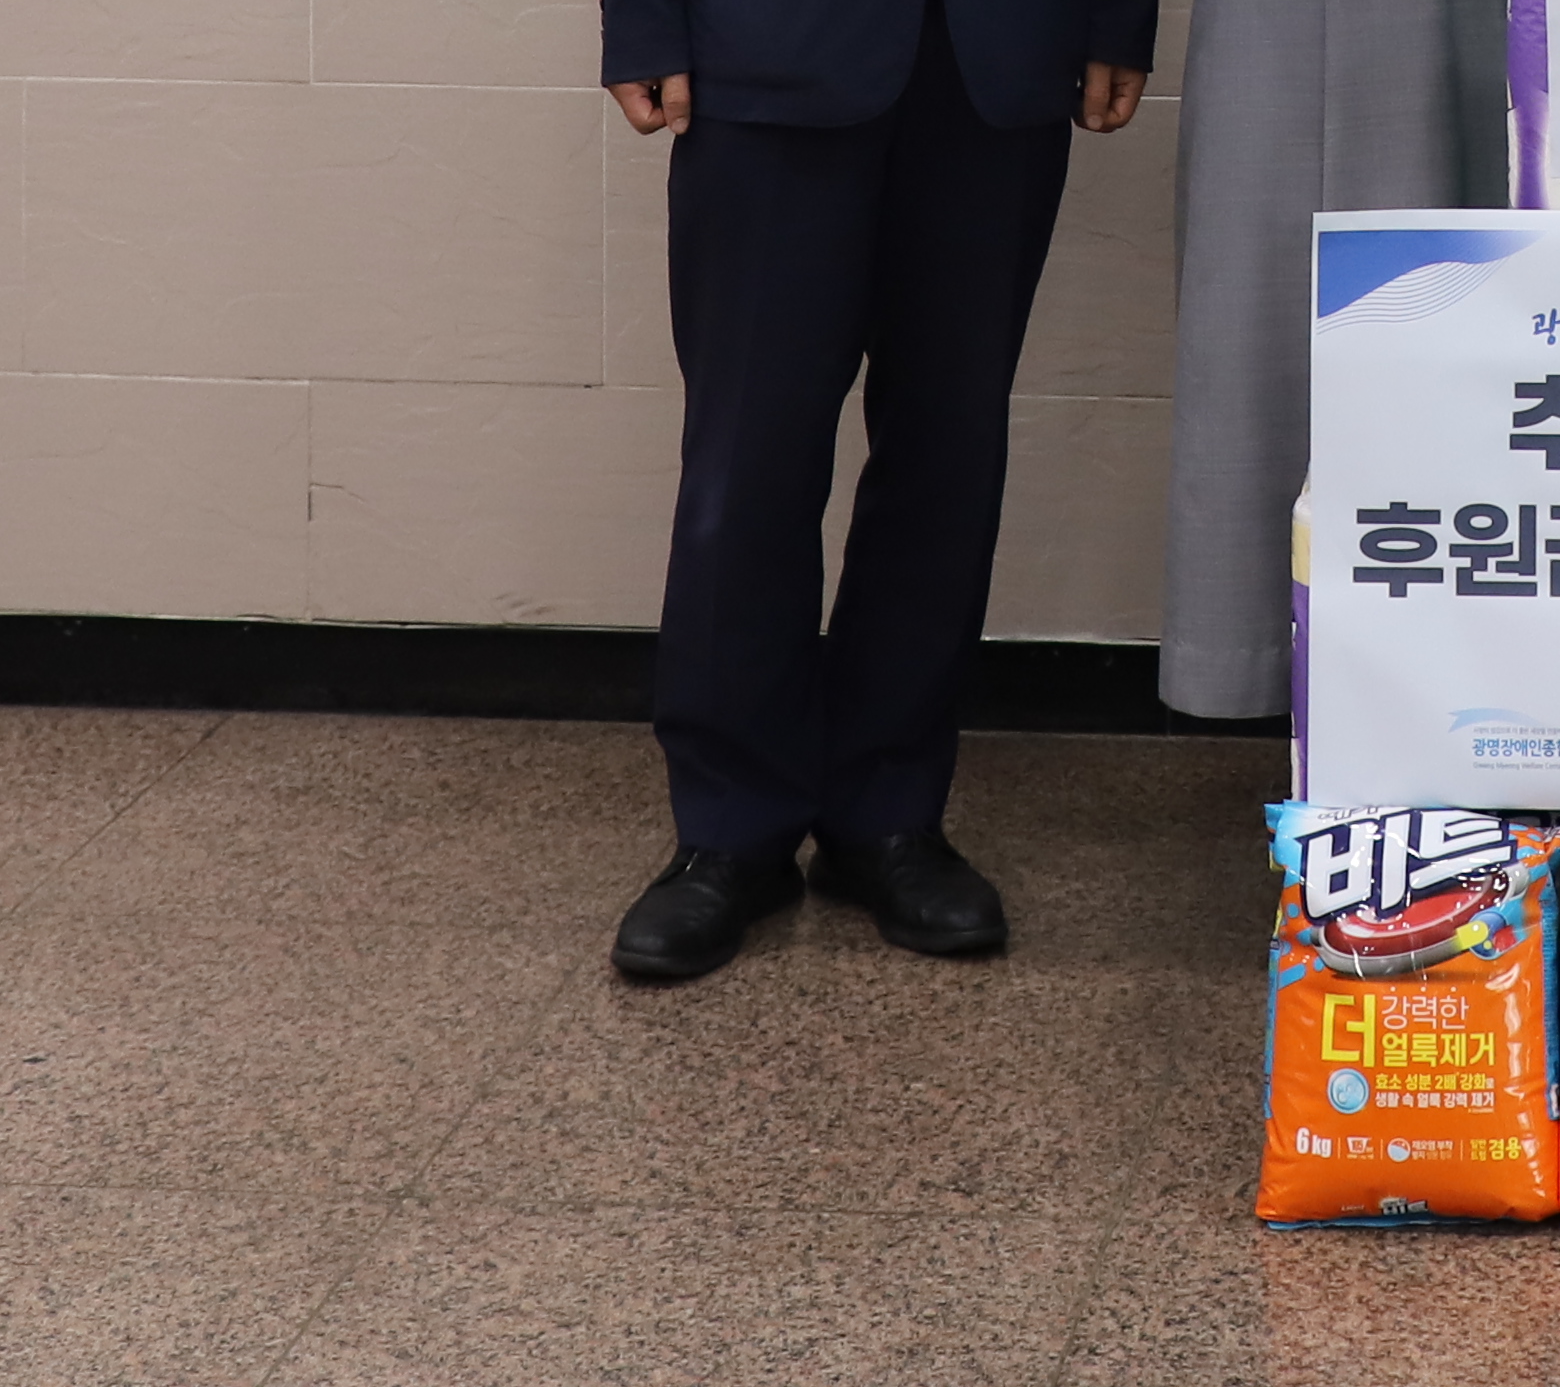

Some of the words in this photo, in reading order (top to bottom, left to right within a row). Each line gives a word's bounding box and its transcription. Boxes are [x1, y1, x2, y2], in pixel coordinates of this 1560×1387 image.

[1304, 809, 1513, 920] 비트
[1381, 995, 1469, 1029] 강력한
[1321, 994, 1376, 1067] 더
[1381, 1032, 1495, 1067] 얼룩제거
[1489, 1137, 1521, 1161] 겸용
